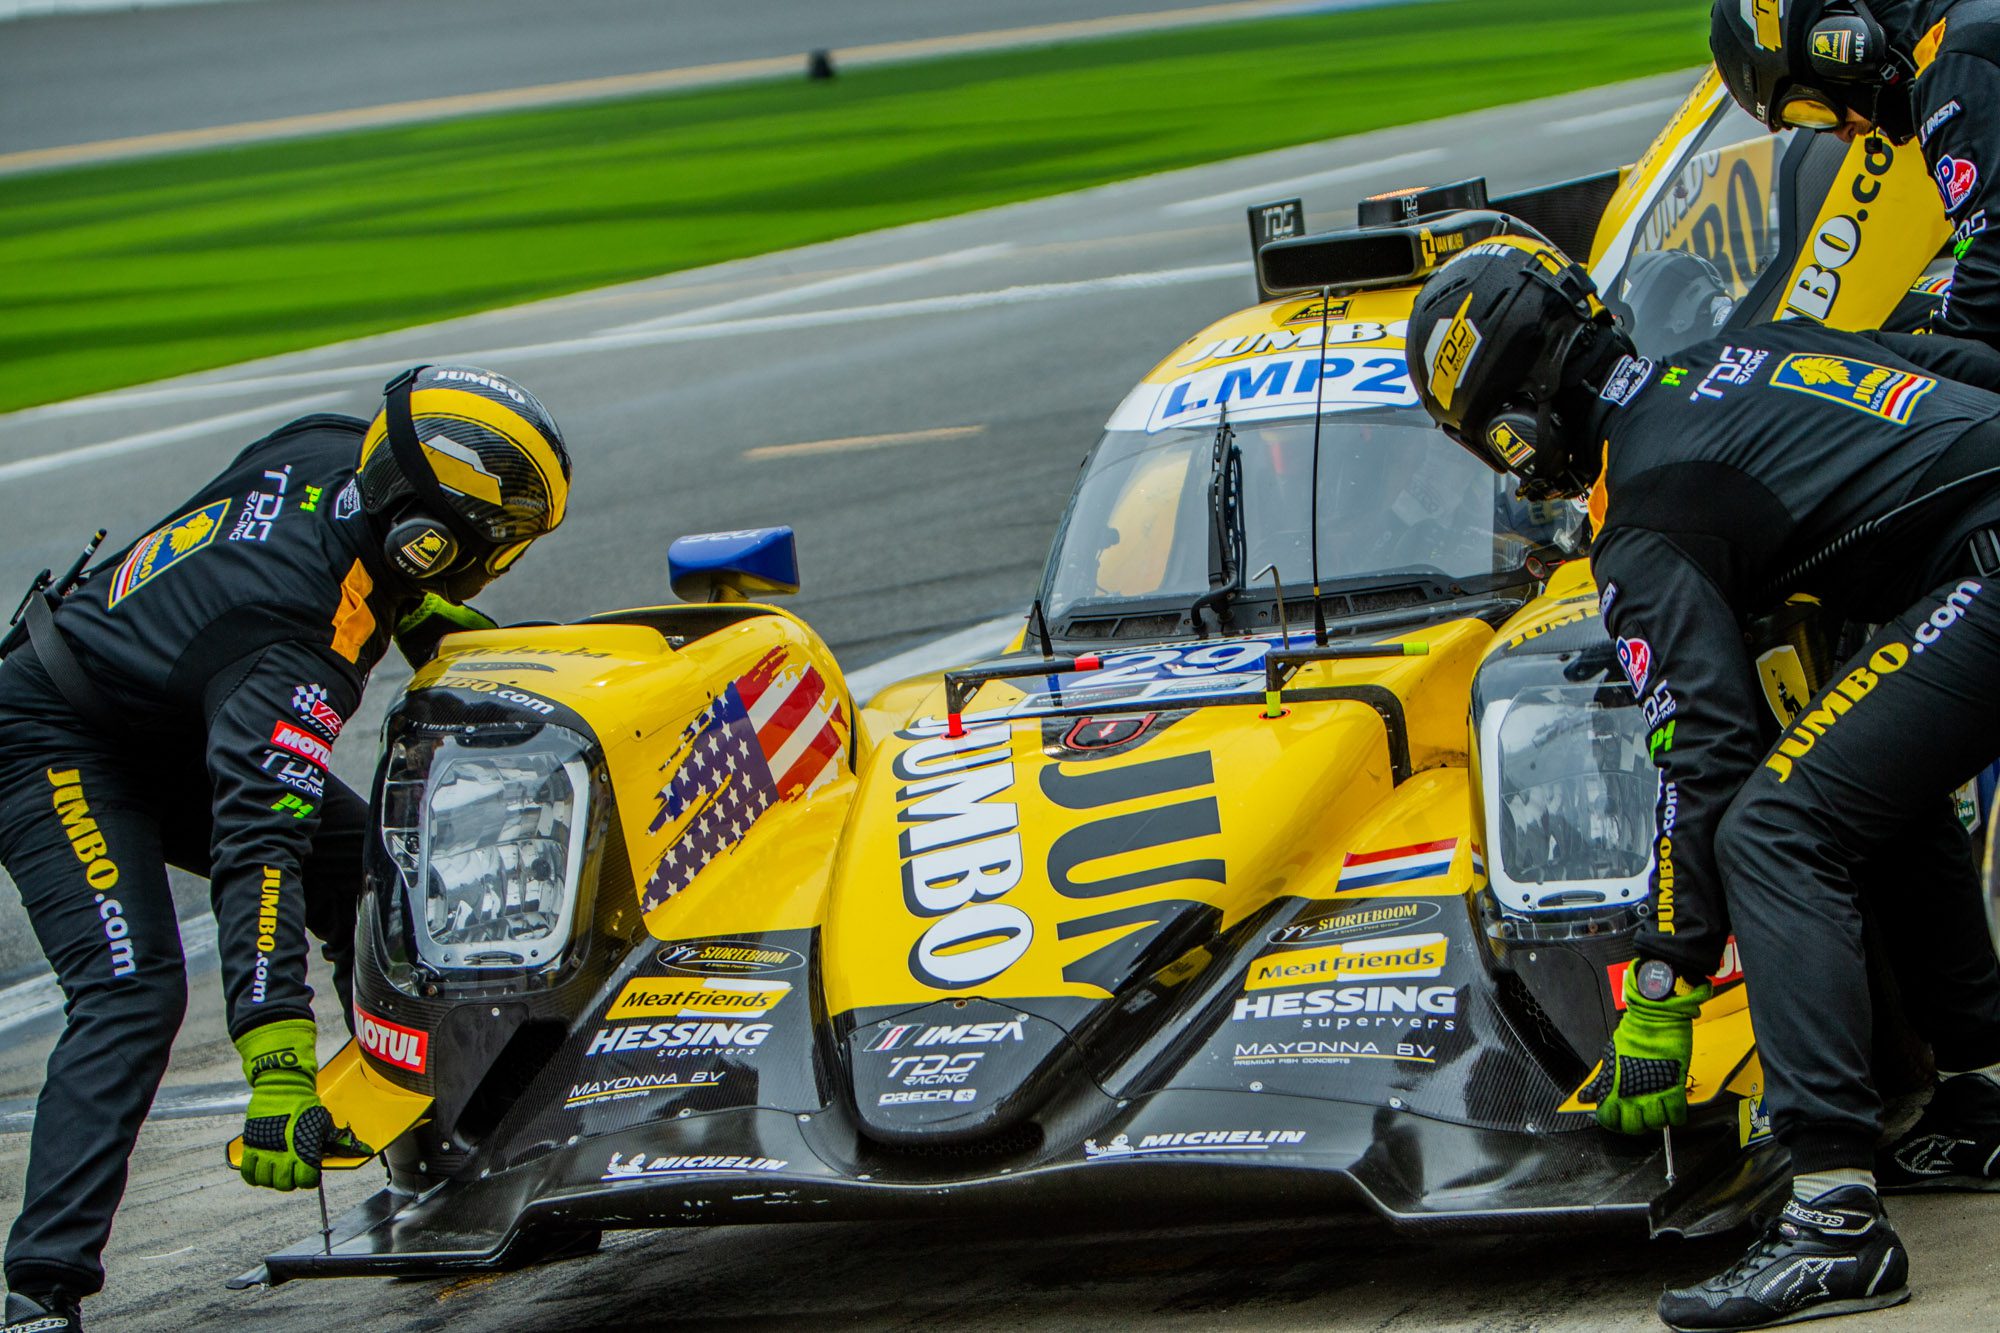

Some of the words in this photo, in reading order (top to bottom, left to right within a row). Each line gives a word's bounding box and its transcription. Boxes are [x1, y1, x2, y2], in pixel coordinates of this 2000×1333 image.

[1927, 100, 1961, 134] IMSA
[1263, 203, 1294, 237] TDS
[1436, 320, 1467, 376] TDS
[1453, 335, 1473, 372] RACING
[1690, 346, 1752, 401] TDS
[1734, 349, 1769, 385] RACING
[433, 370, 526, 404] JUMBO
[1162, 357, 1409, 419] LMP2
[1853, 369, 1891, 404] JUMBO
[229, 490, 259, 541] RACING
[242, 464, 292, 542] TDS
[1067, 641, 1272, 688] 29
[1765, 579, 1982, 784] JUMBO.com
[277, 774, 323, 797] RACING
[894, 712, 1034, 990] JUMBO
[1656, 782, 1677, 936] JUMBO.com
[48, 768, 136, 977] JUMBO.com
[253, 865, 283, 1003] JUMBO.com
[1318, 903, 1418, 931] STORTEBOOM
[700, 946, 791, 964] STORTEBOOM
[1232, 986, 1457, 1020] HESSING
[586, 1023, 773, 1056] HESSING
[913, 1021, 1024, 1048] IMSA
[1302, 1017, 1456, 1031] supervers
[657, 1047, 757, 1058] supervers
[888, 1051, 985, 1078] TDS
[1233, 1058, 1275, 1066] PREMIUM
[1235, 1041, 1380, 1056] MAYONNA
[1396, 1043, 1436, 1057] BV
[569, 1072, 678, 1098] MAYONNA
[690, 1071, 726, 1083] BV
[878, 1089, 954, 1104] ORECA
[902, 1073, 969, 1086] RACING
[1138, 1130, 1307, 1148] MICHELIN
[646, 1156, 789, 1171] MICHELIN
